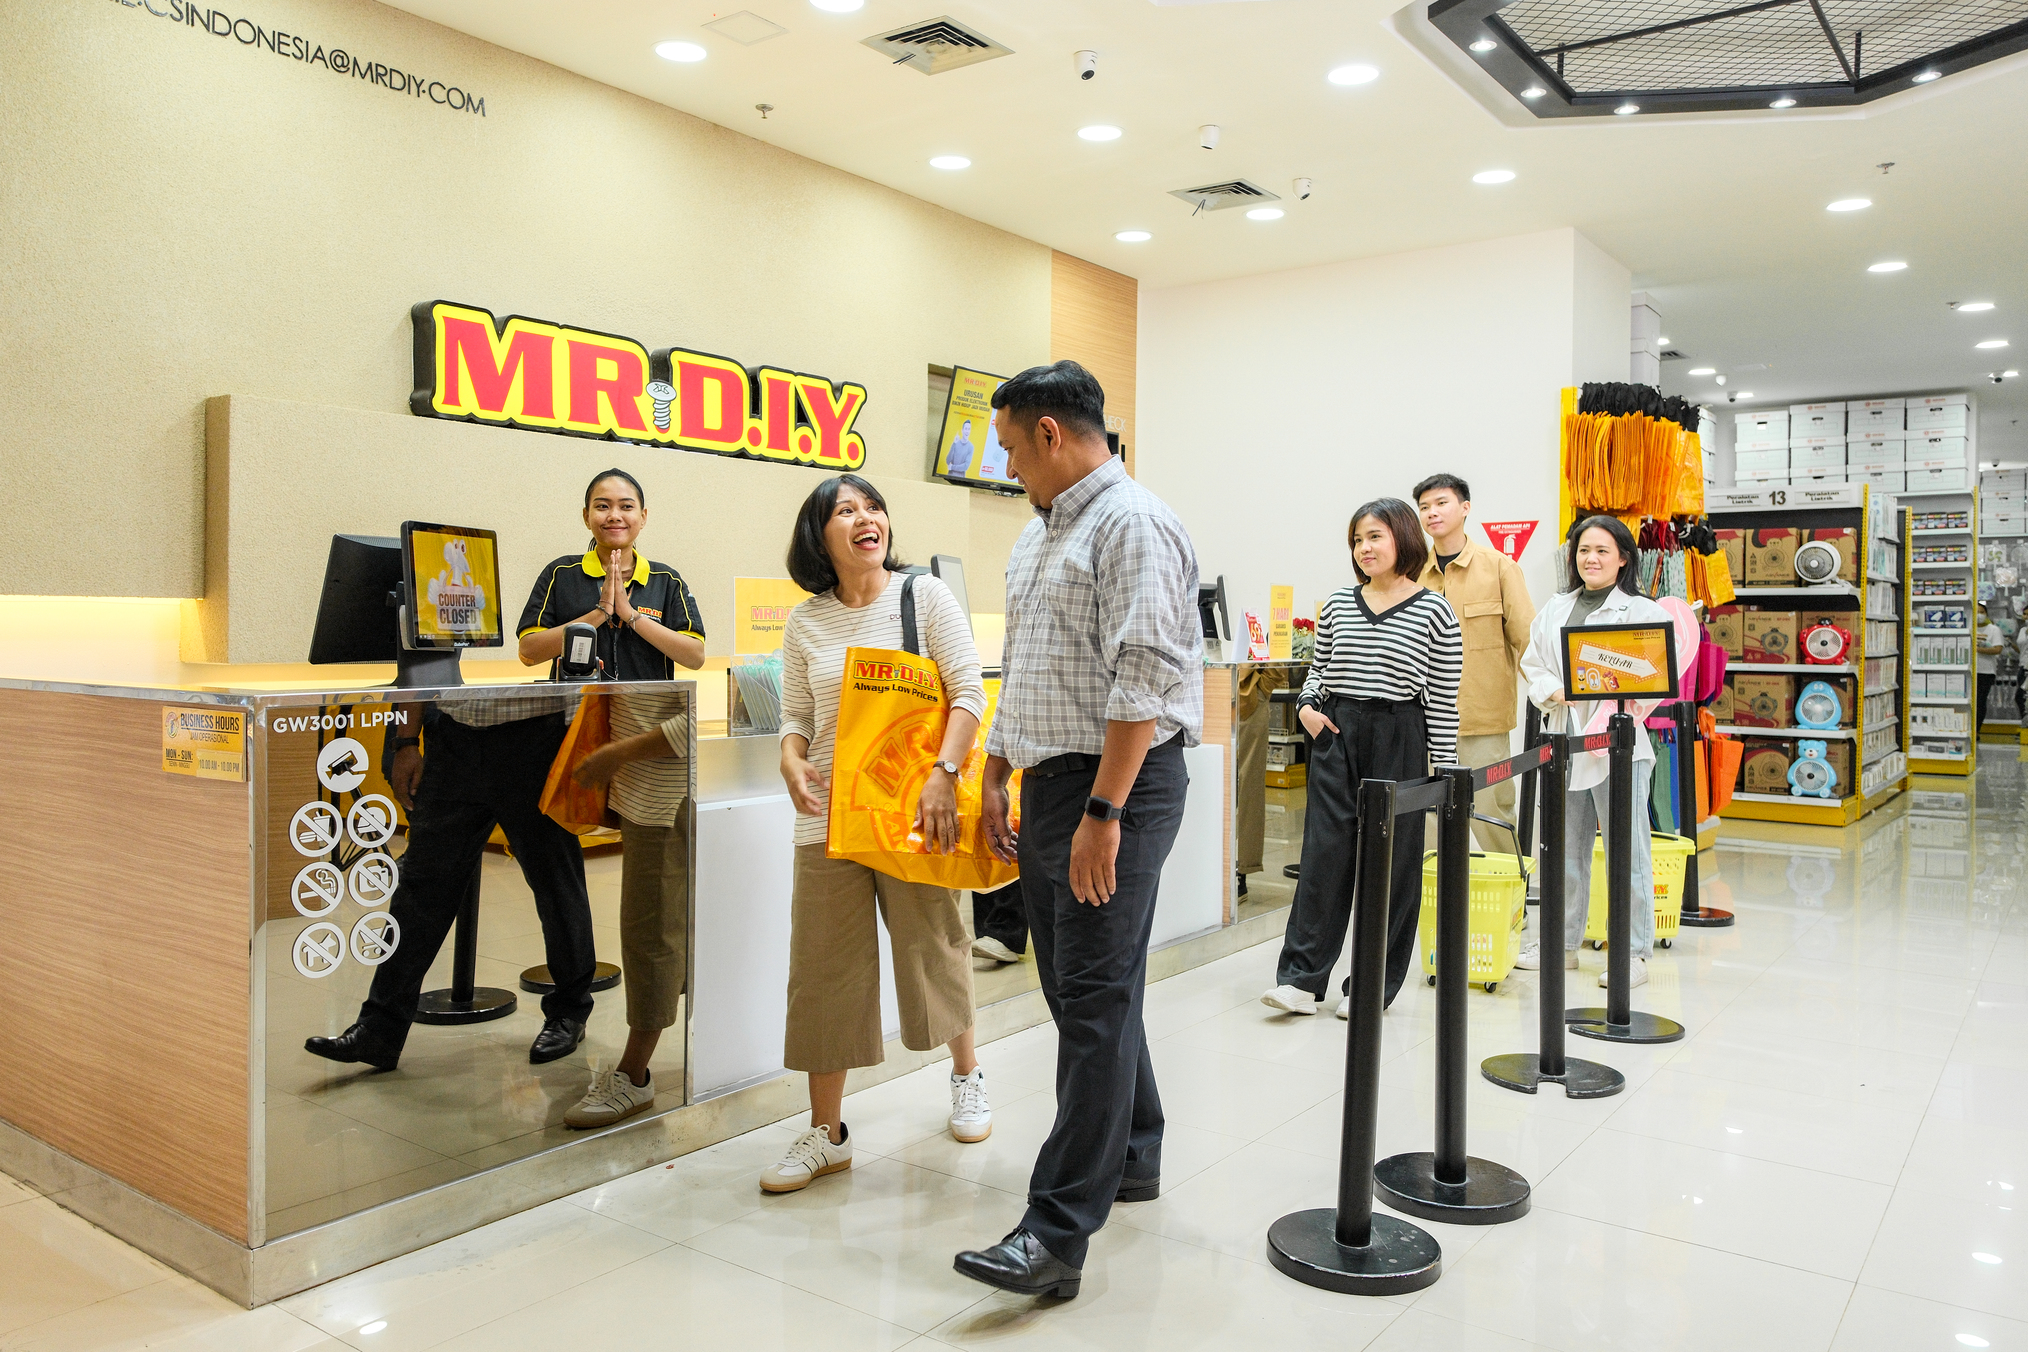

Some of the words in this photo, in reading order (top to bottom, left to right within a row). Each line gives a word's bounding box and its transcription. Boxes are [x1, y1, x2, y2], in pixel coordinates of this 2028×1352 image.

[1103, 414, 1127, 433] HECK
[1768, 490, 1787, 506] 13
[438, 593, 476, 608] COUNTER
[439, 608, 477, 625] CLOSED
[751, 624, 772, 632] Always
[1598, 652, 1633, 669] KELUAR
[853, 682, 890, 694] Always
[891, 683, 911, 695] Low
[911, 688, 938, 703] Prices
[180, 713, 214, 729] BUSINESS
[215, 715, 240, 731] HOURS
[272, 713, 355, 733] GW3001
[361, 710, 408, 728] LPPN
[199, 732, 229, 744] OPERASIONAL
[165, 748, 177, 759] MON
